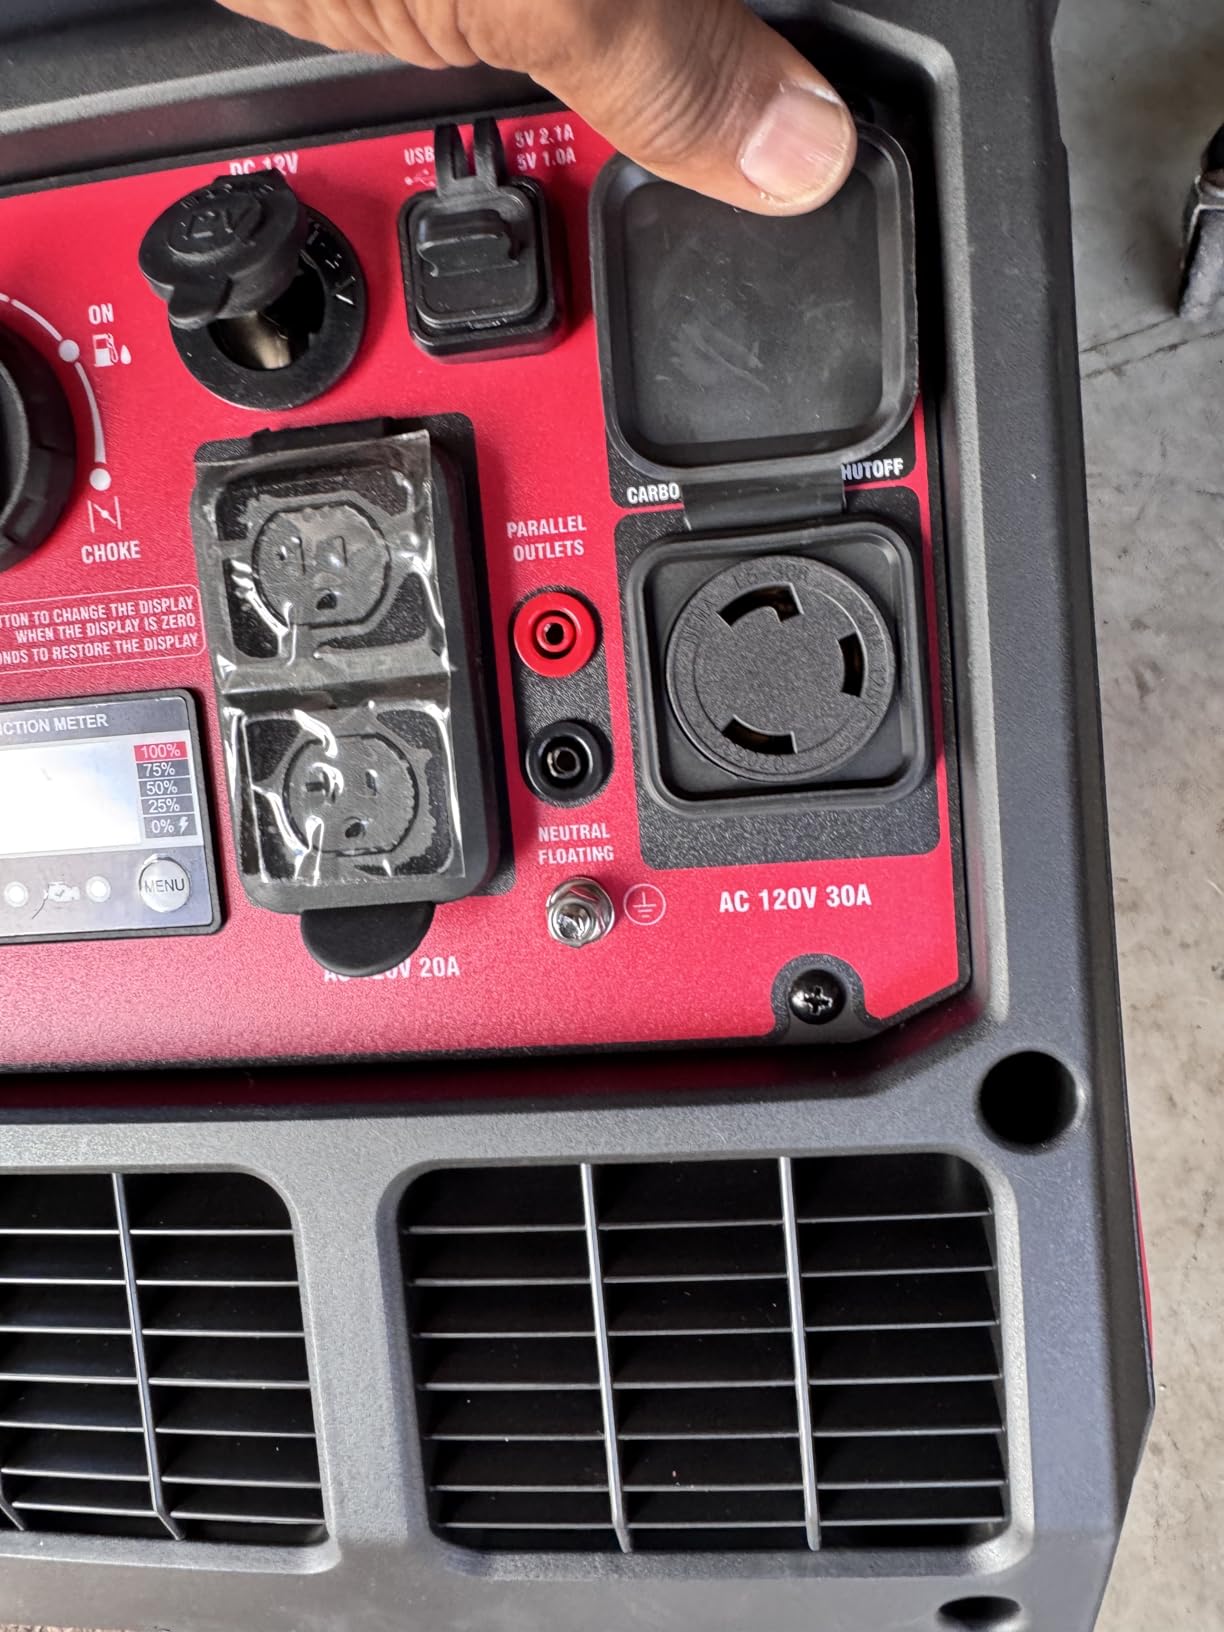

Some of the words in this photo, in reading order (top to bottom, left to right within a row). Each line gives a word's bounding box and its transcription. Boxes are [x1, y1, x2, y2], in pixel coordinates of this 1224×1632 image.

[514, 128, 534, 148] 5V
[539, 123, 575, 145] 2.1A
[229, 159, 256, 176] DC
[262, 151, 299, 175] 12V
[404, 145, 435, 166] USB
[516, 151, 537, 171] 5V
[542, 146, 577, 168] 1.0A
[88, 303, 115, 325] ON
[627, 482, 680, 505] CARBO
[840, 457, 904, 481] HUTOFF
[506, 514, 587, 539] PARALLEL
[81, 540, 142, 564] CHOKE
[513, 539, 585, 562] OUTLETS
[32, 610, 50, 625] TO
[53, 604, 107, 622] CHANGE
[109, 602, 136, 617] THE
[139, 596, 194, 614] DISPLAY
[15, 627, 54, 643] WHEN
[57, 624, 83, 639] THE
[86, 618, 140, 637] DISPLAY
[144, 616, 158, 631] IS
[161, 612, 196, 629] ZERO
[0, 649, 29, 665] NDS
[31, 647, 49, 662] TO
[52, 641, 112, 660] RESTORE
[114, 639, 141, 654] THE
[143, 632, 198, 651] DISPLAY
[0, 718, 51, 736] CTION
[53, 713, 109, 732] METER
[140, 743, 181, 759] 100%
[143, 761, 176, 777] 75%
[146, 780, 178, 795] 50%
[148, 797, 180, 814] 25%
[151, 819, 175, 834] 0%
[537, 822, 611, 842] NEUTRAL
[538, 845, 614, 865] FLOATING
[144, 877, 186, 893] MENU
[719, 890, 750, 913] AC
[758, 886, 817, 911] 120V
[825, 883, 872, 908] 30A
[419, 955, 461, 978] 20A
